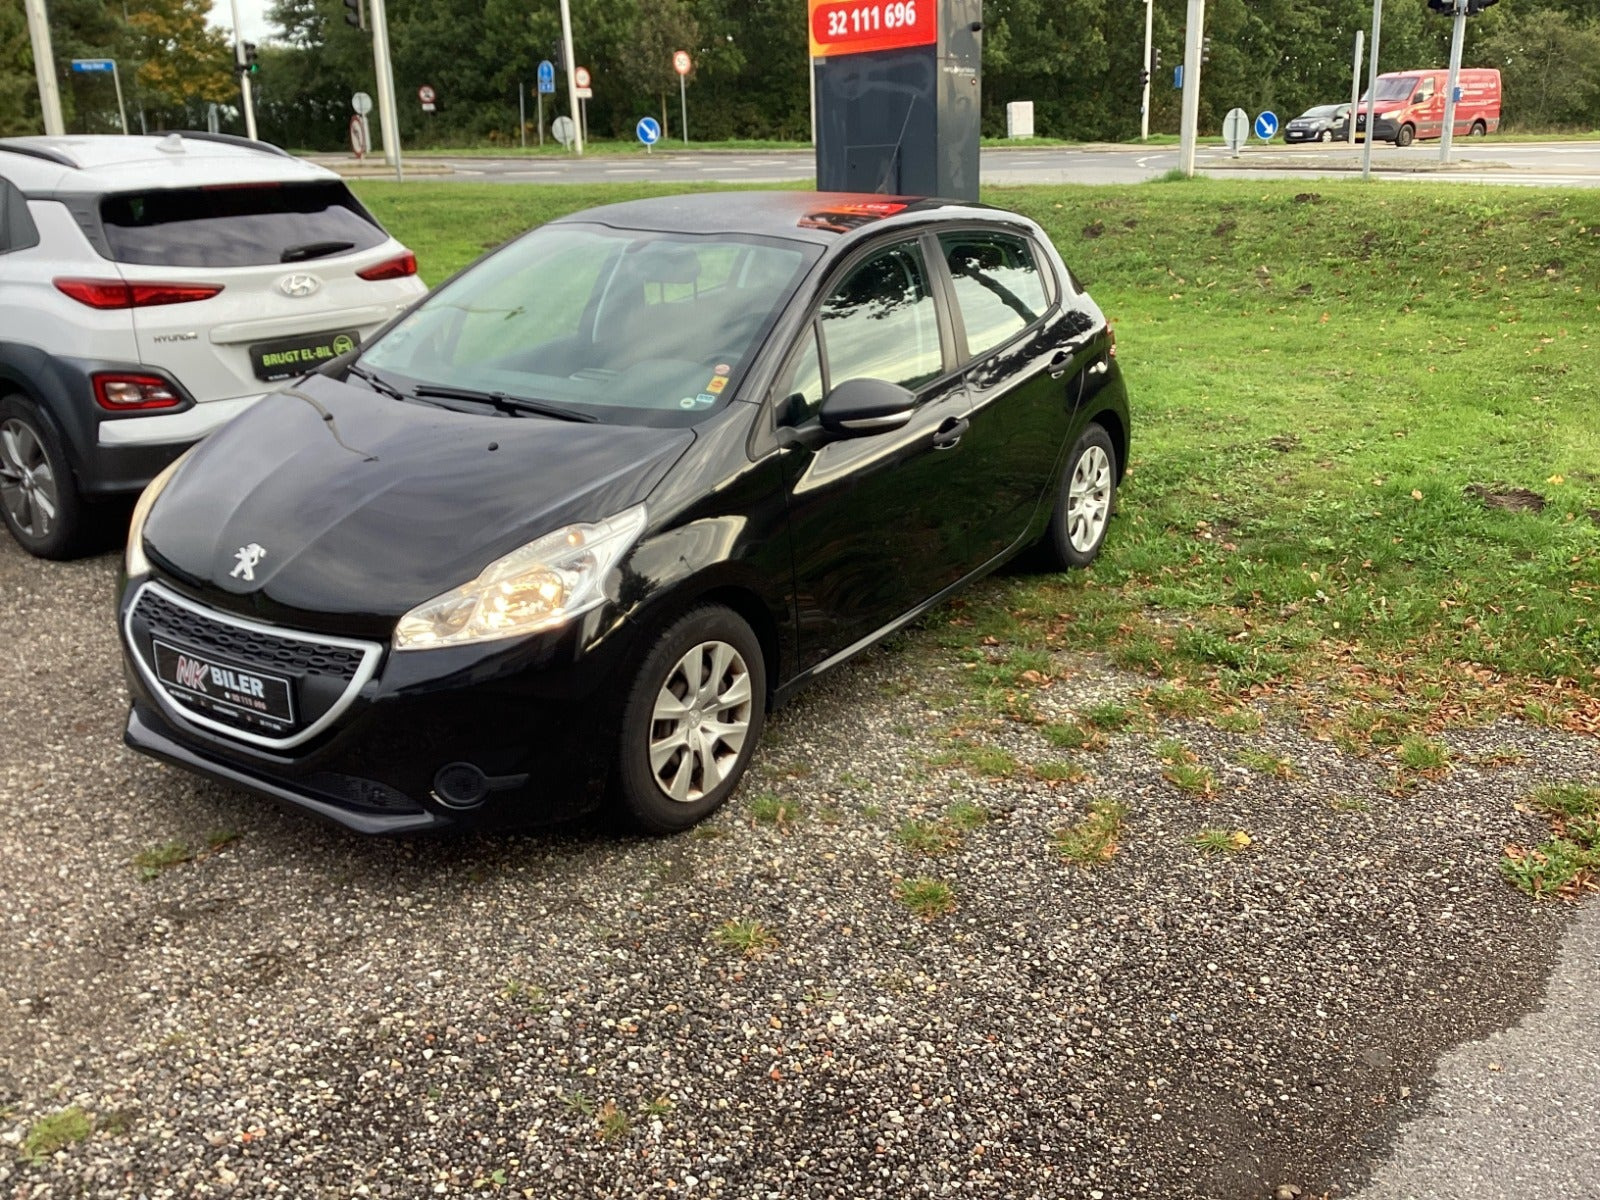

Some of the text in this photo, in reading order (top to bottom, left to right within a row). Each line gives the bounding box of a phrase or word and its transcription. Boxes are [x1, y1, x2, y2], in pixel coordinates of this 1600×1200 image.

[827, 0, 916, 36] 32 111 696
[262, 345, 333, 367] BRUGT EL-BIL
[176, 655, 264, 698] NK BILER
